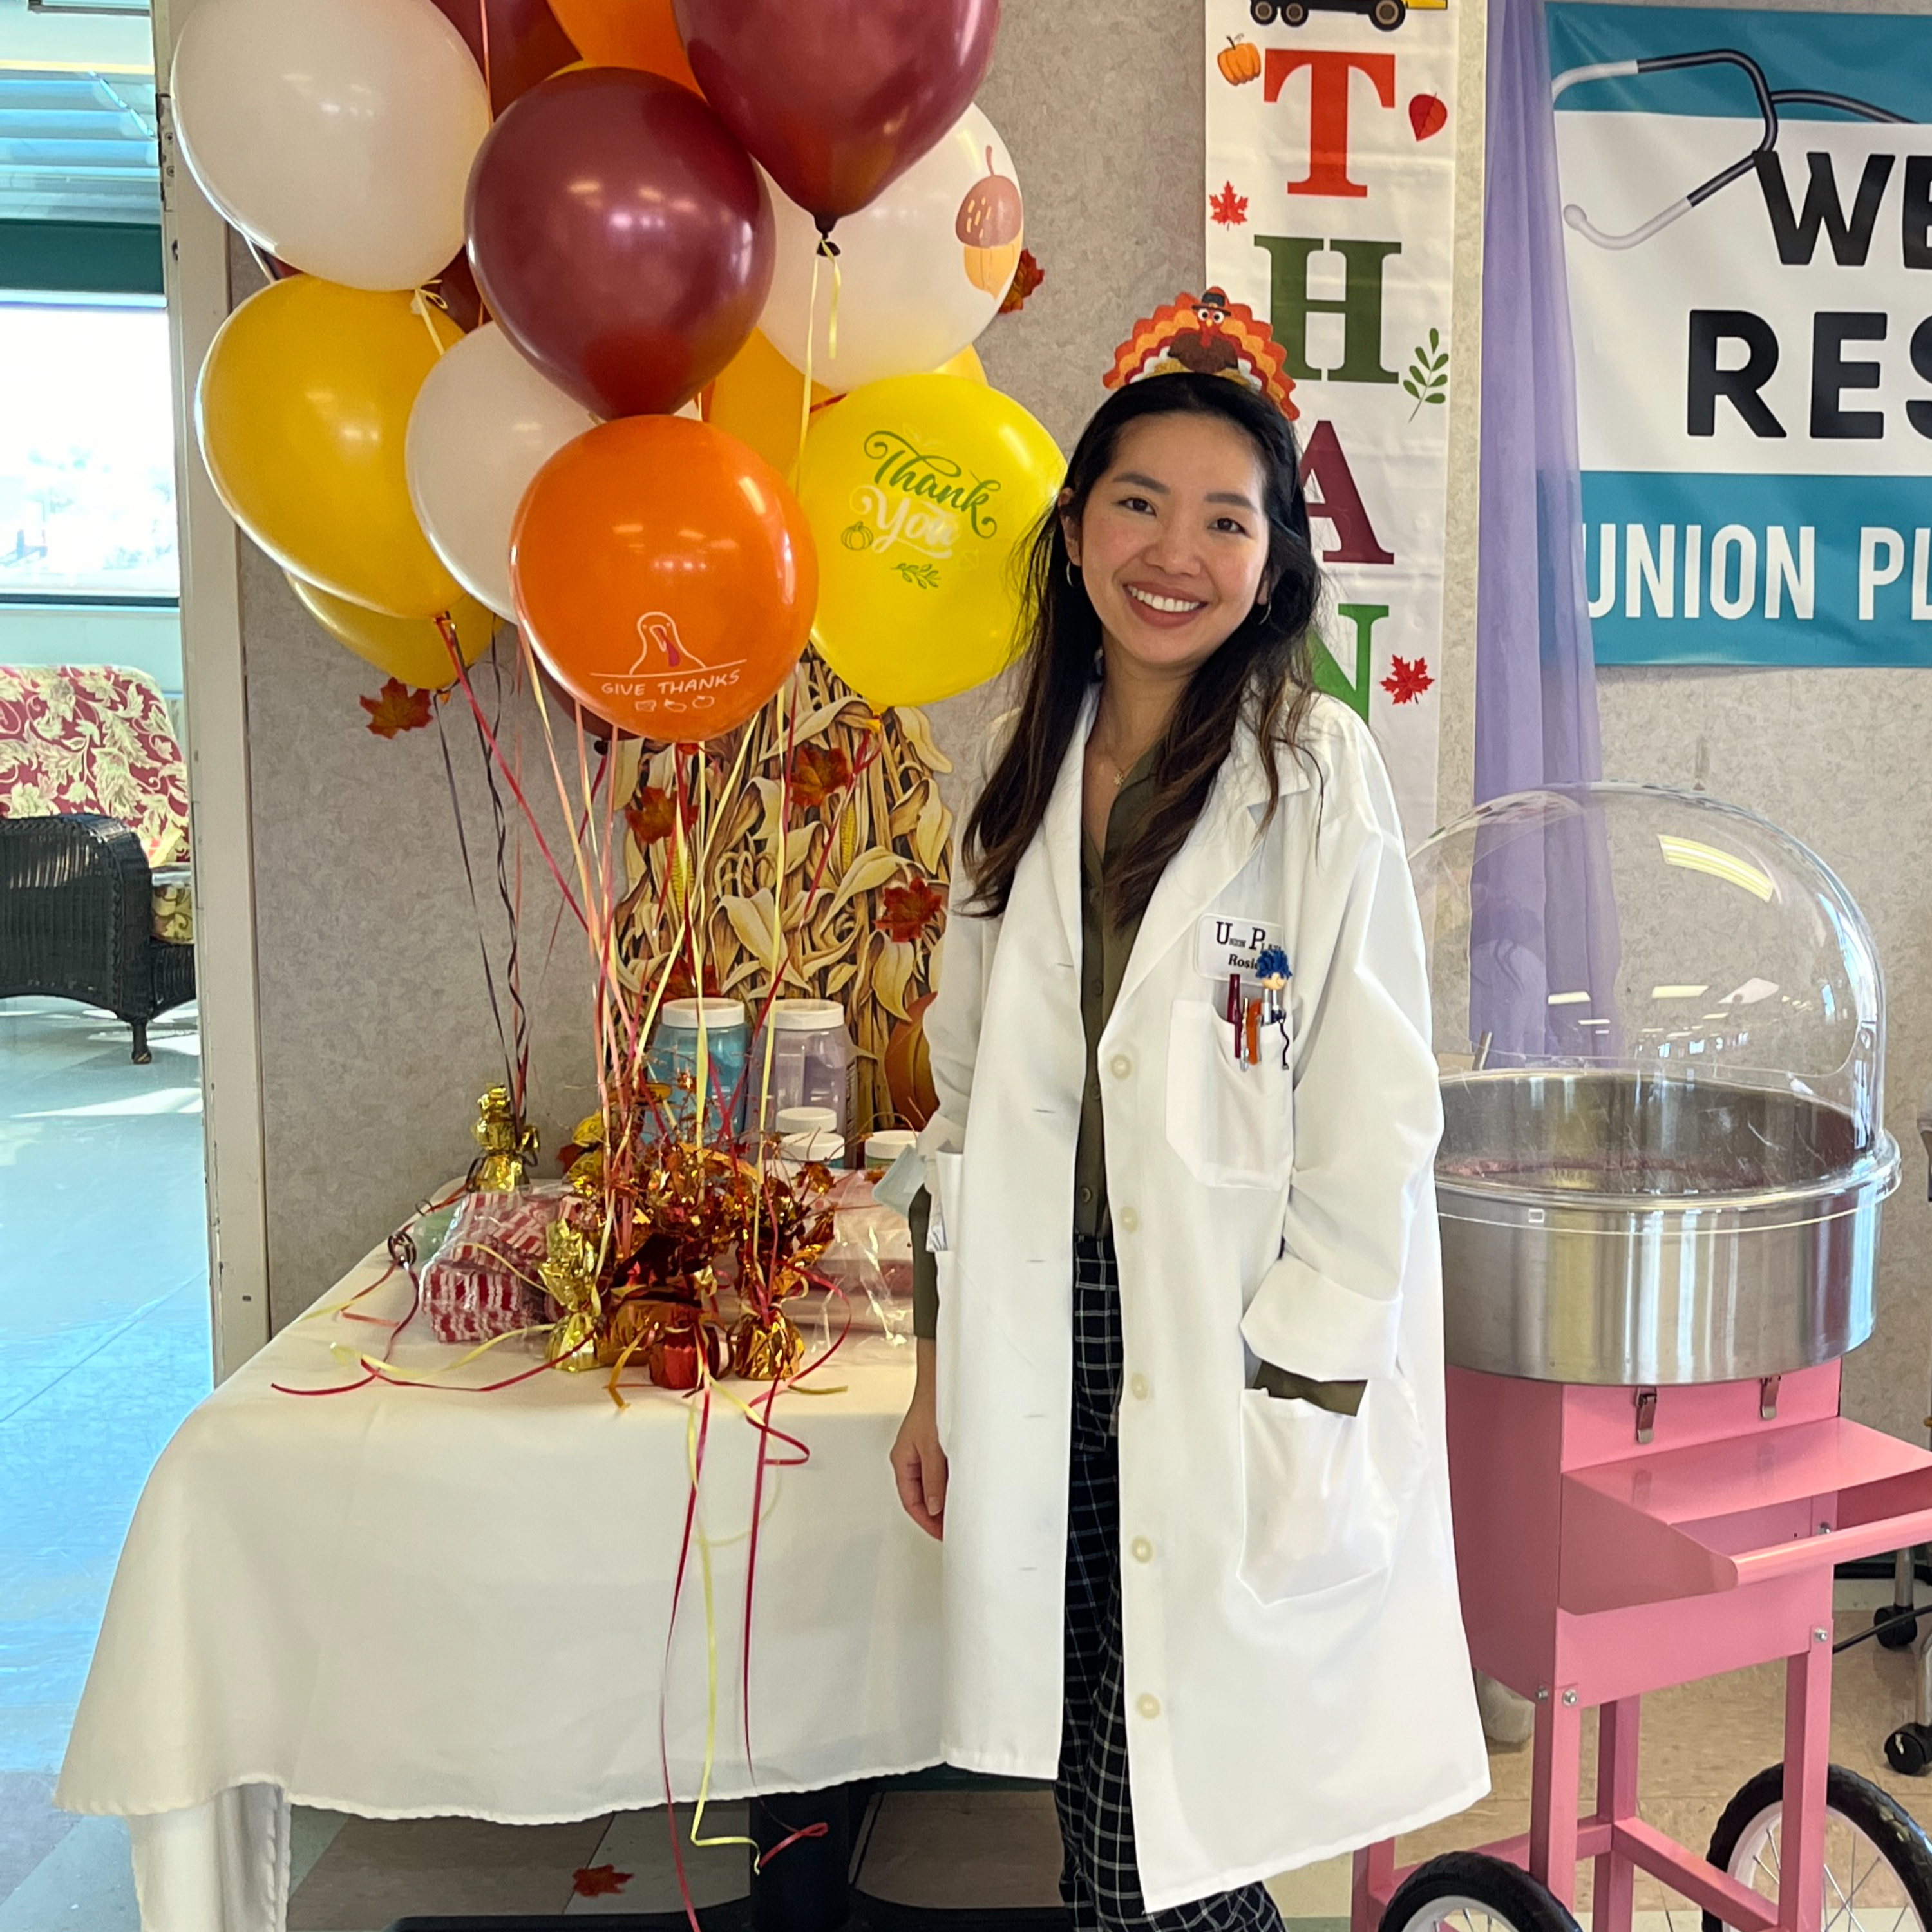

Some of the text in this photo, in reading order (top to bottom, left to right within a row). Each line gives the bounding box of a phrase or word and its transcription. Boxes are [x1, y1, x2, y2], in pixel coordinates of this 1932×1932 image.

[849, 485, 958, 559] You
[864, 430, 1001, 538] Thank
[1582, 524, 1815, 620] UNION
[601, 669, 741, 696] GIVE THANKS
